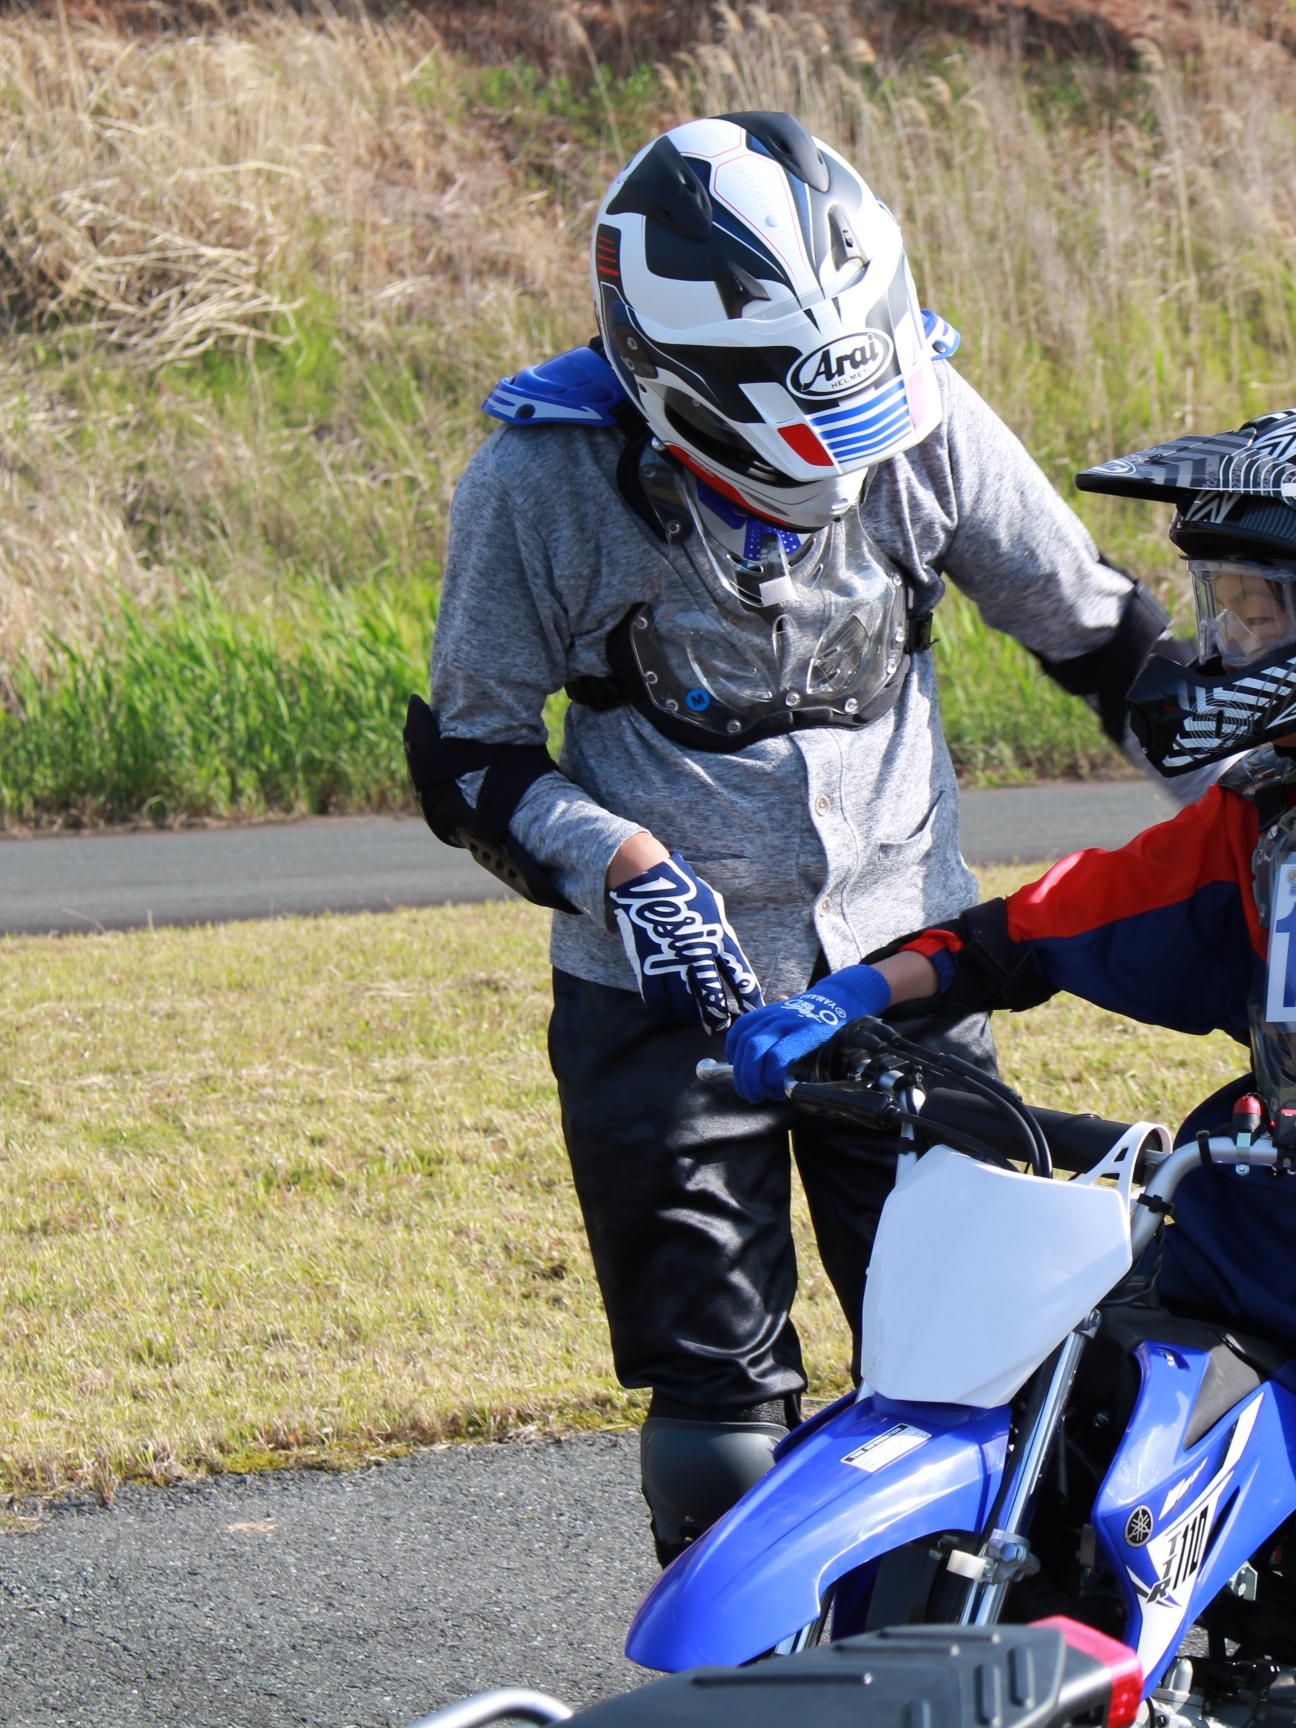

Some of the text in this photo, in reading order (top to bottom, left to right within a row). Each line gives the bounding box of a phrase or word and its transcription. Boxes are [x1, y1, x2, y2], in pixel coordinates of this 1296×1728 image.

[800, 334, 879, 391] Arai
[691, 693, 706, 707] M
[1172, 1504, 1209, 1590] 110
